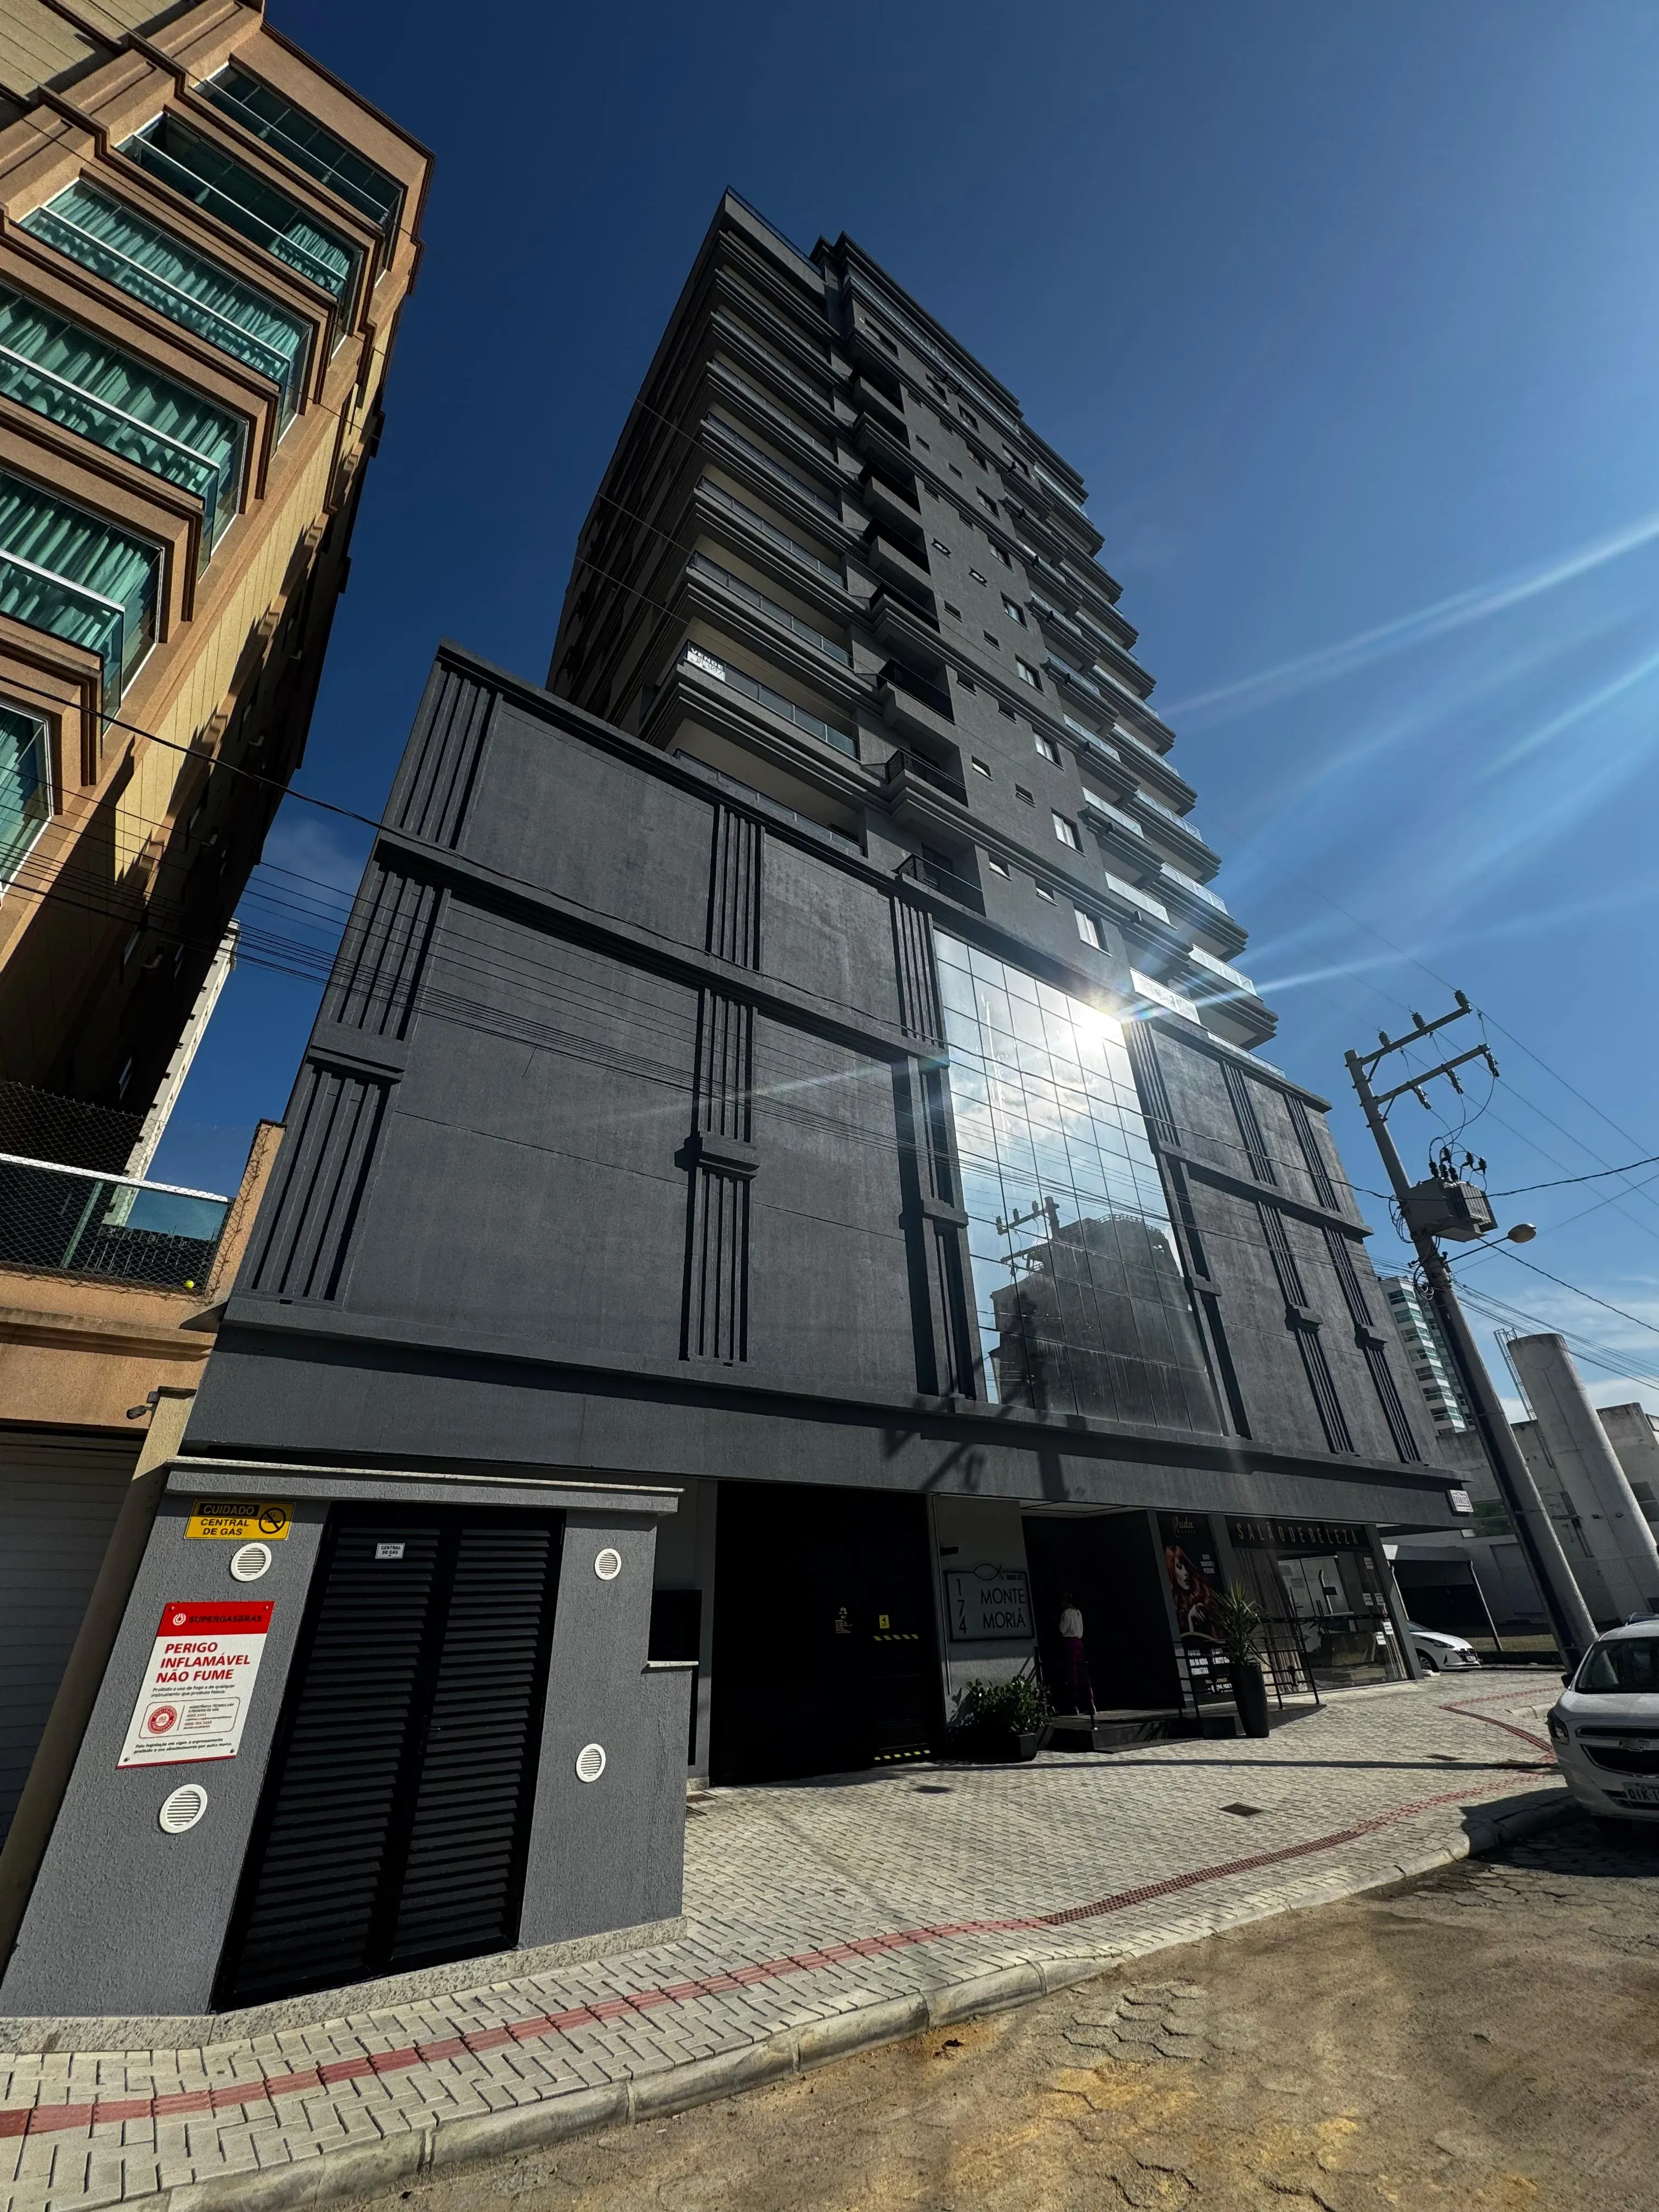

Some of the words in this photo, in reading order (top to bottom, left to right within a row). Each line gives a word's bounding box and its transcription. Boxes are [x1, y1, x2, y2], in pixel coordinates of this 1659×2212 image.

[691, 647, 724, 670] VENDE
[204, 1505, 254, 1515] CUIDADO
[221, 1526, 242, 1536] GÁS
[1237, 1521, 1285, 1542] SALÃO
[1288, 1527, 1306, 1543] DE
[1308, 1527, 1358, 1544] BELEZA
[981, 1588, 1025, 1604] MONTE
[189, 1615, 262, 1623] SUPERGASBRAS
[983, 1607, 1026, 1629] MORIÁ
[165, 1642, 218, 1654] PERIGO
[160, 1652, 250, 1668] INFLAMÁVEL
[156, 1669, 189, 1683] NÃO
[193, 1669, 234, 1681] FUME
